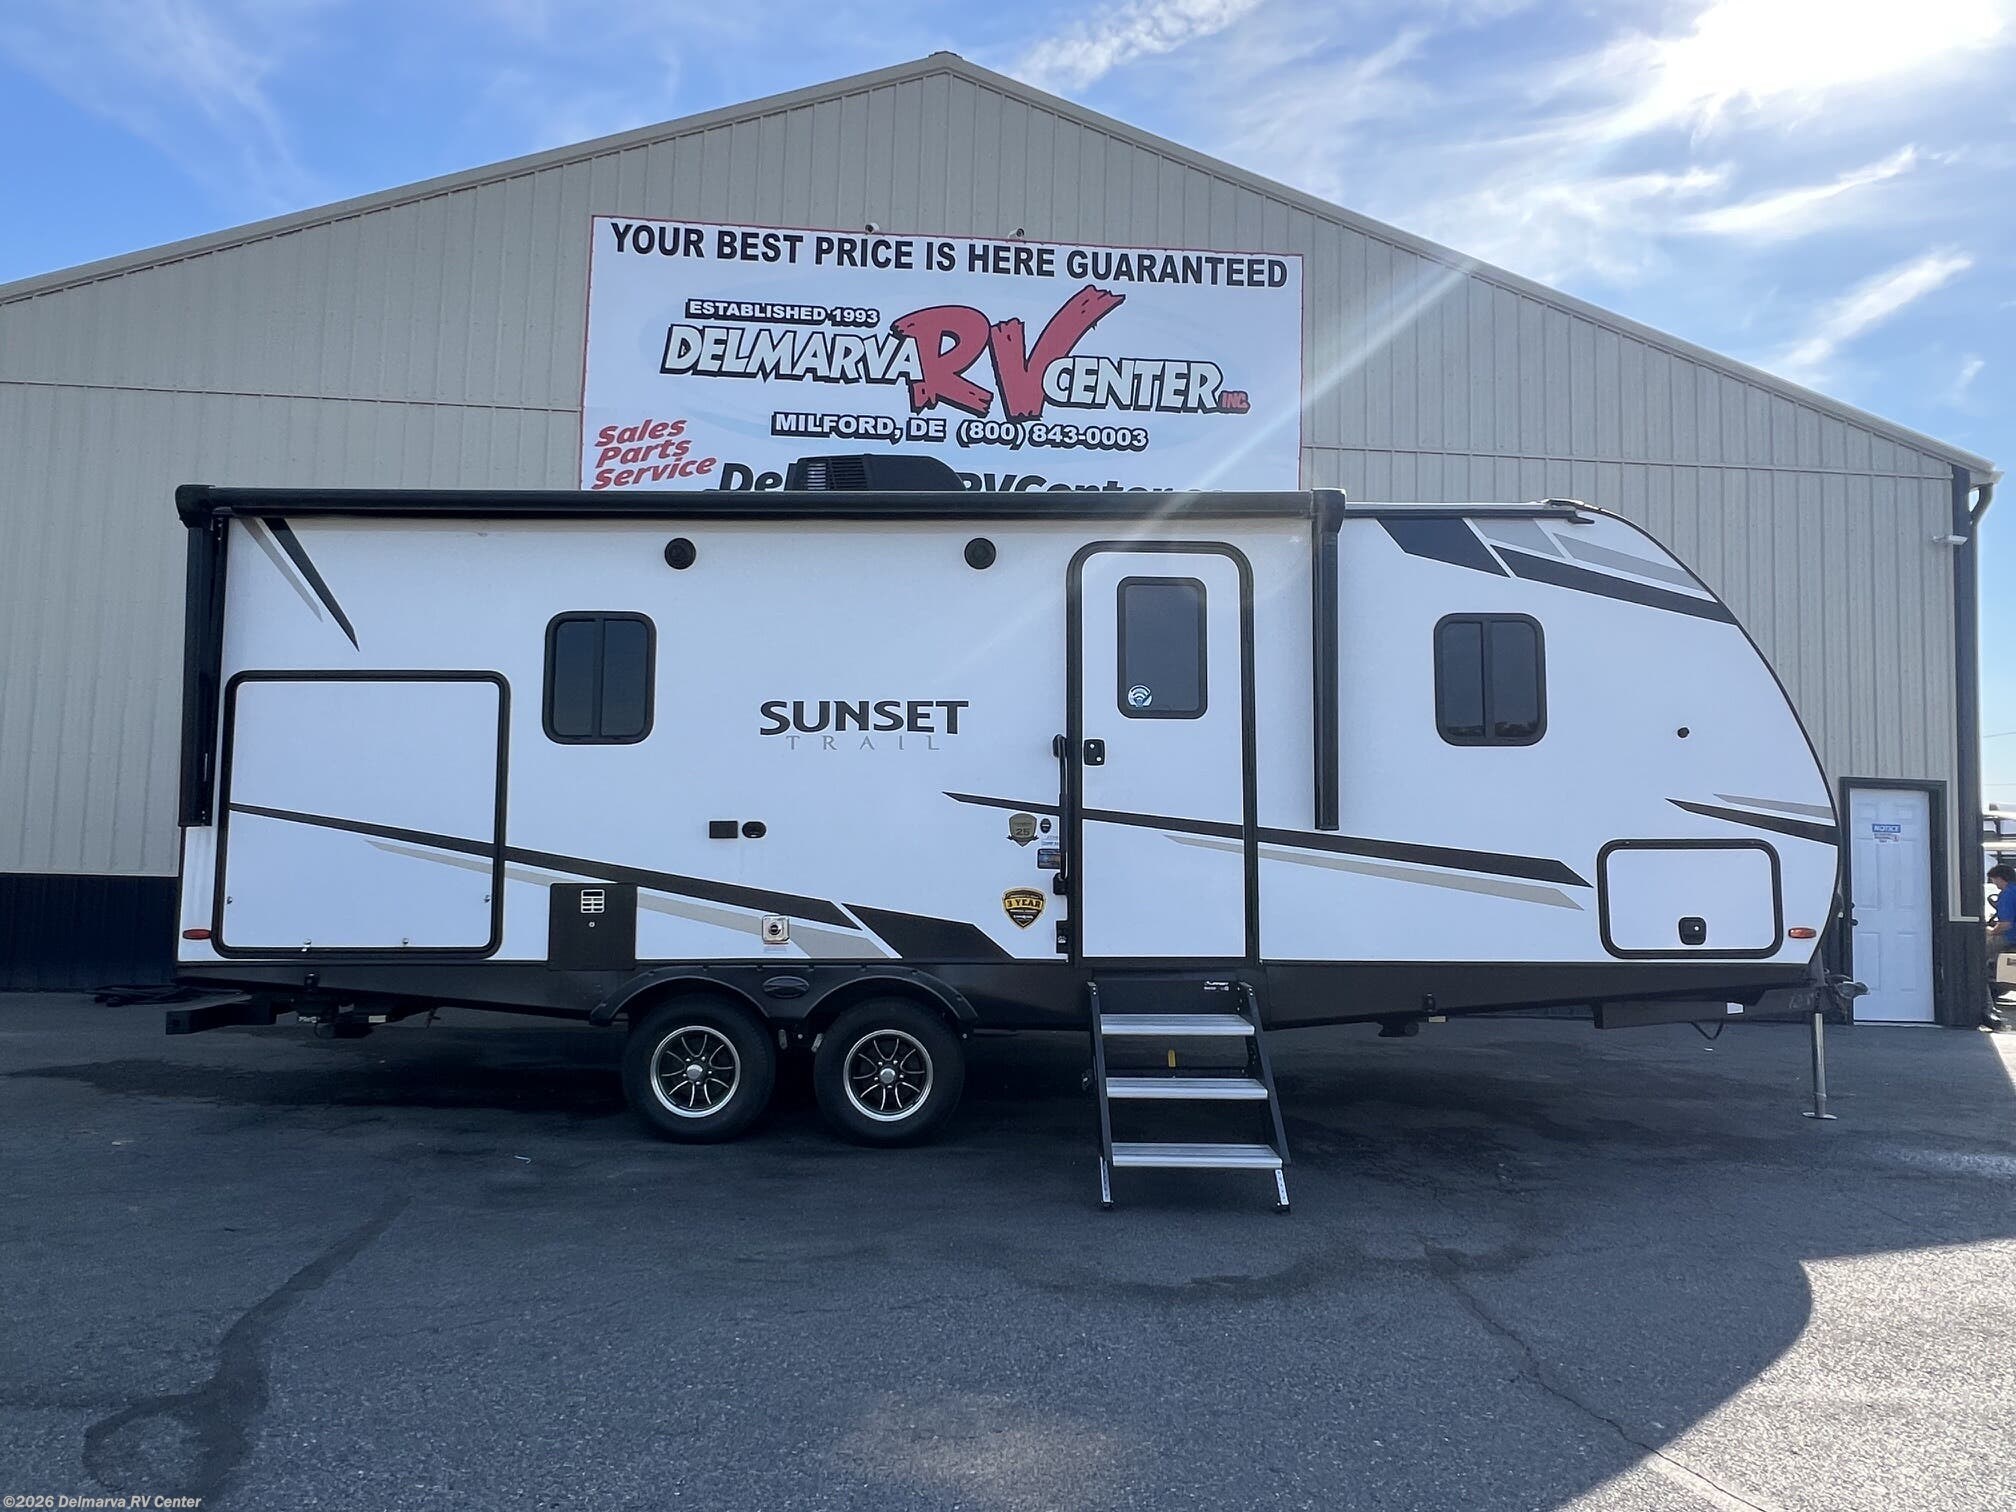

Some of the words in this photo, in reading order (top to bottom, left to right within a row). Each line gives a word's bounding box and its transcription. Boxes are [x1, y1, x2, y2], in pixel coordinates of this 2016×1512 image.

[611, 222, 705, 259] YOUR
[717, 230, 803, 264] BEST
[815, 236, 914, 270] PRICE
[926, 241, 956, 272] IS
[968, 244, 1055, 277] HERE
[1067, 251, 1287, 287] GUARANTEED
[687, 299, 828, 323] ESTABLISHED
[831, 307, 880, 326] 1993
[661, 324, 925, 384] DELMARVA
[890, 284, 1126, 421] RV
[1043, 355, 1223, 413] CENTER
[594, 419, 688, 447] Sales
[771, 412, 903, 444] MILFORD,
[908, 418, 948, 442] DE
[957, 420, 1025, 450] (800)
[1029, 424, 1148, 451] 843-0003
[595, 439, 692, 469] Parts
[591, 457, 717, 490] Service
[760, 700, 969, 735] SUNSET
[786, 735, 940, 750] TRAIL
[1015, 828, 1030, 836] 25
[1015, 899, 1041, 908] YEAR
